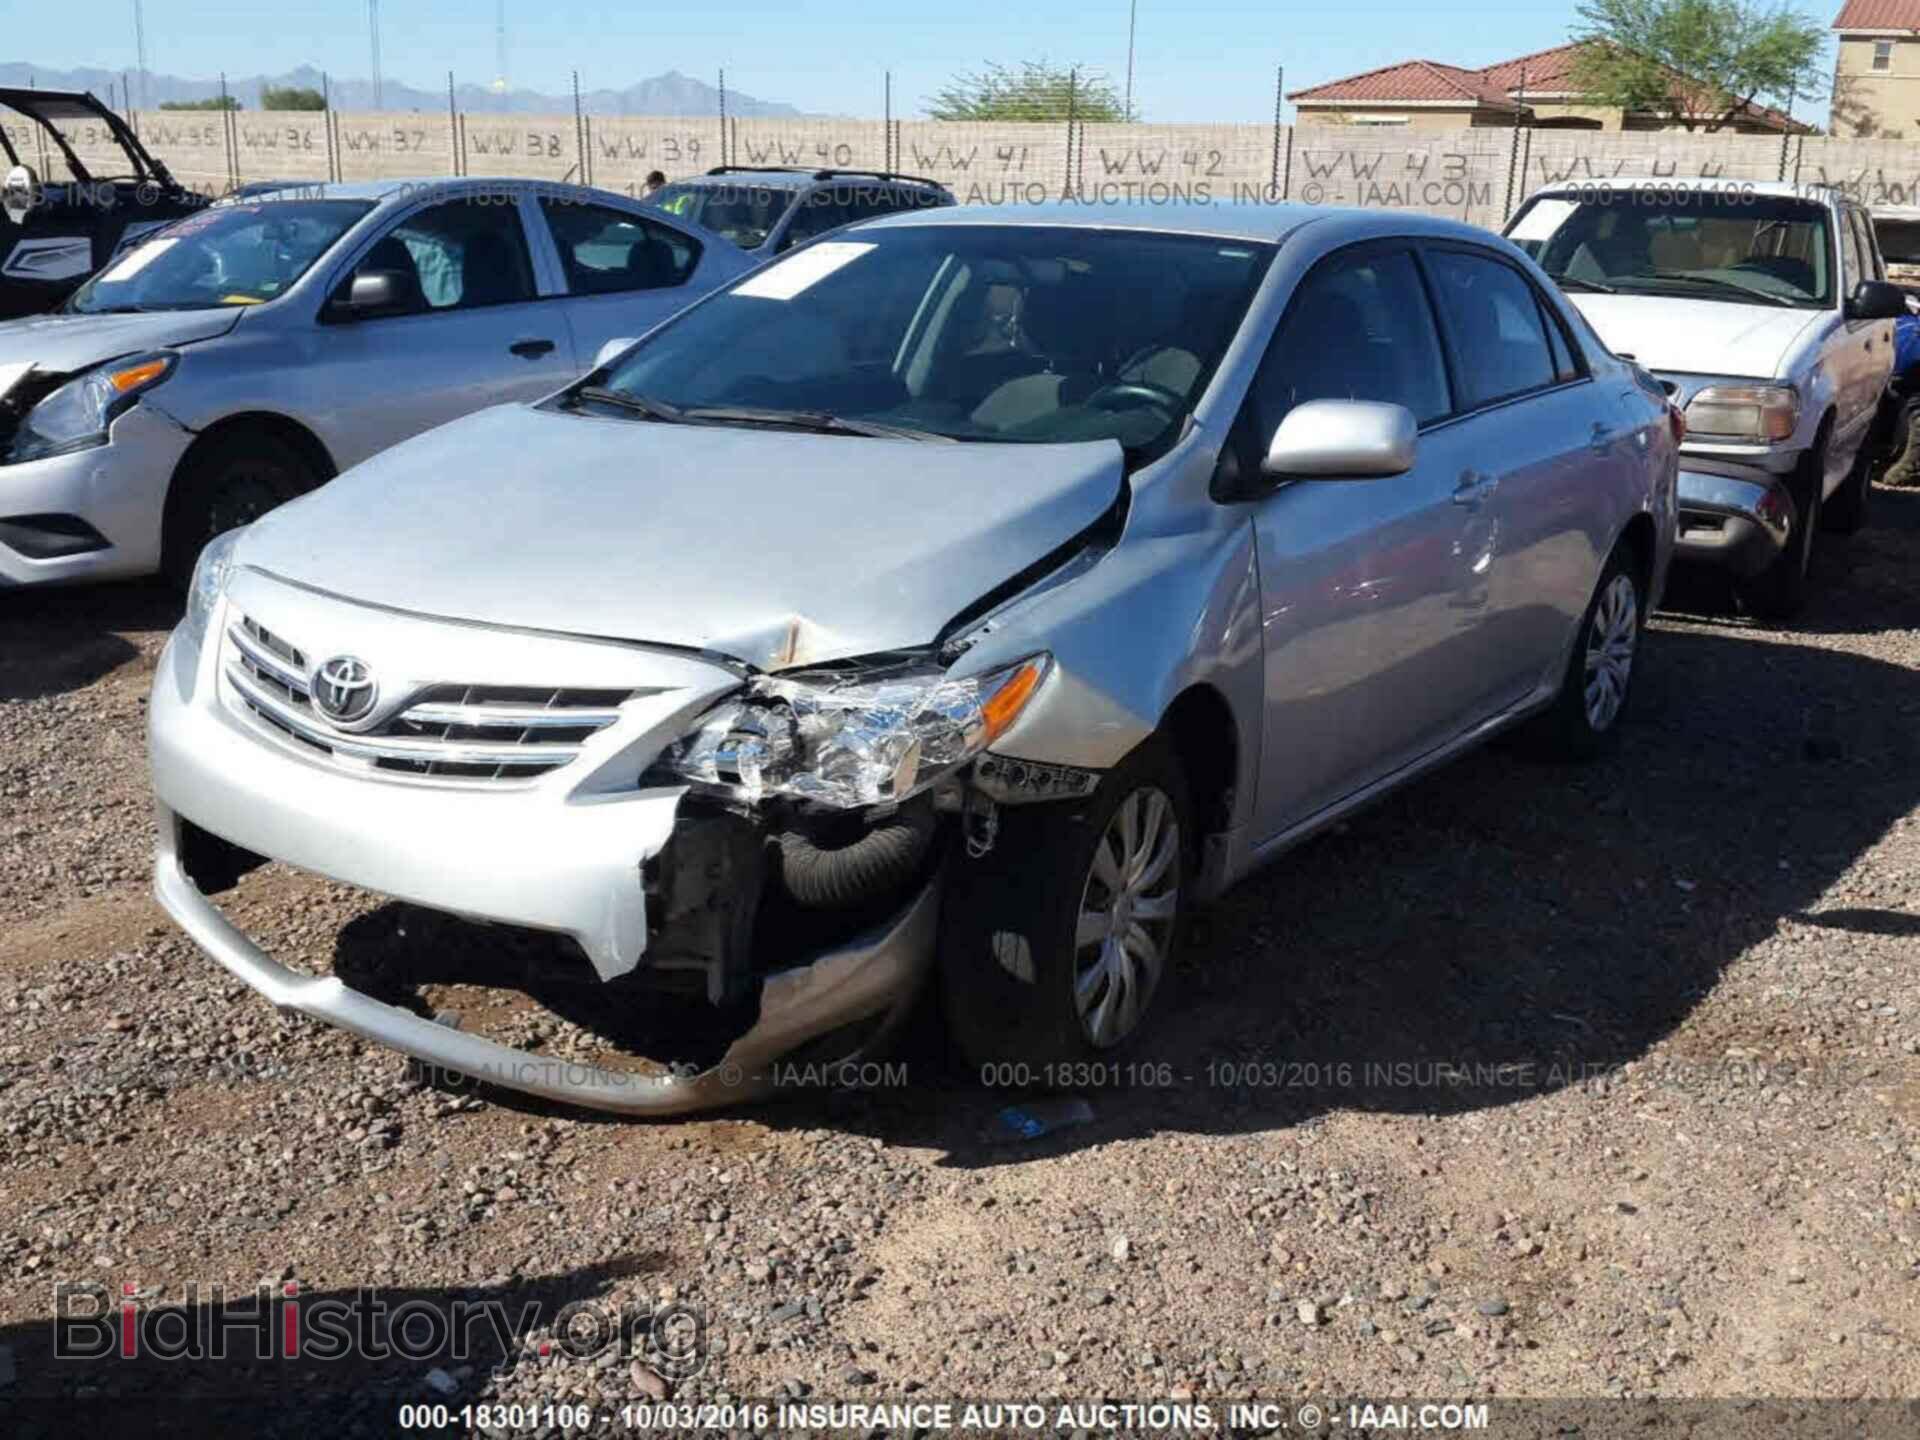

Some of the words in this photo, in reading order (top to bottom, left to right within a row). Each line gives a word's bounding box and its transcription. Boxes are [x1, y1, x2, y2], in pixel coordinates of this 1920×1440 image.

[242, 129, 279, 150] WW
[286, 129, 314, 150] 36
[344, 131, 381, 151] WW
[394, 130, 425, 152] 37
[472, 134, 514, 155] WW
[526, 134, 561, 158] 38
[600, 135, 648, 159] WW
[662, 137, 700, 162] 39
[744, 137, 804, 165] WW
[816, 143, 853, 167] 40
[911, 143, 978, 172] WW
[996, 146, 1028, 172] 41
[1099, 148, 1165, 175] WW
[1183, 149, 1225, 177] 42
[1302, 152, 1383, 179] WW
[1407, 153, 1468, 181] 43
